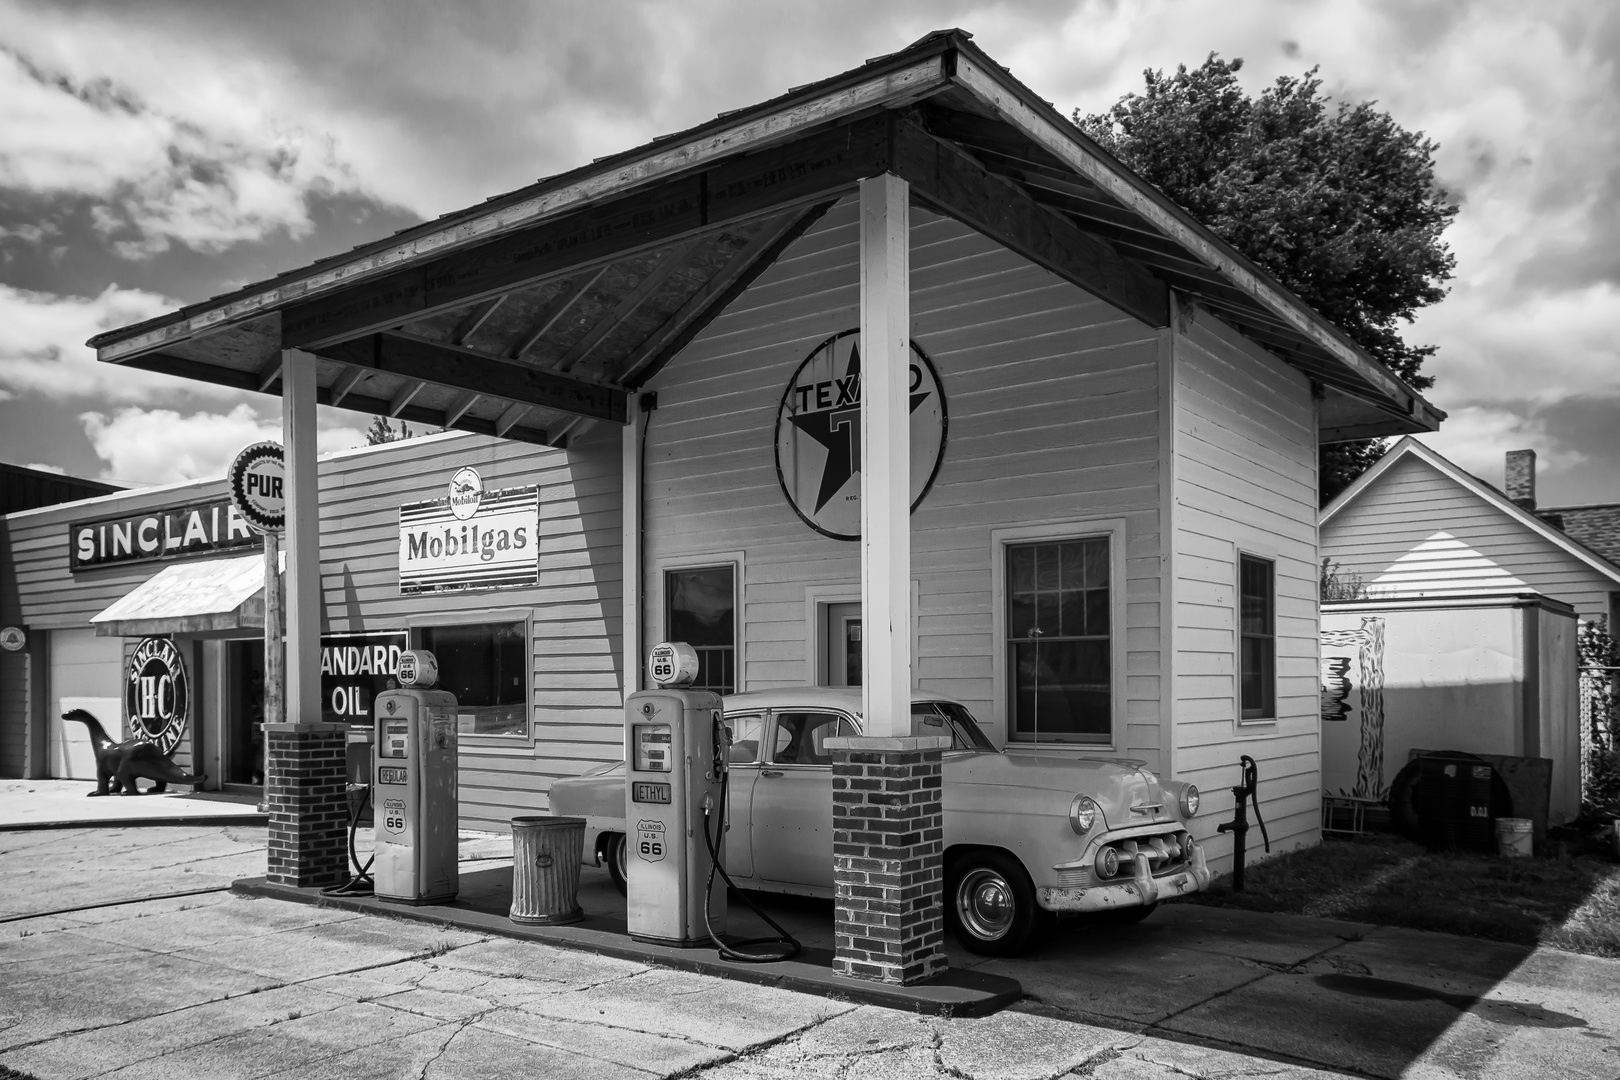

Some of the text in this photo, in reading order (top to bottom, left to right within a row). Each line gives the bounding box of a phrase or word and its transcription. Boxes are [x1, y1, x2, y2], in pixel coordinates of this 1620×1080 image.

[796, 364, 923, 412] TEXO
[247, 473, 284, 499] PUR
[452, 494, 478, 506] Mobiloil
[77, 504, 251, 561] SINCLAIR
[407, 524, 527, 562] Mobilgas
[131, 639, 180, 685] SINCLAIR
[320, 644, 402, 676] ANDARD
[400, 670, 414, 679] 66
[654, 664, 671, 675] 66
[331, 686, 368, 716] OIL
[382, 769, 407, 783] REGULAR
[640, 785, 667, 801] ETHYL
[386, 817, 403, 829] 66
[640, 823, 662, 831] ILLINOIS
[643, 832, 659, 840] U.S.
[640, 841, 662, 856] 66
